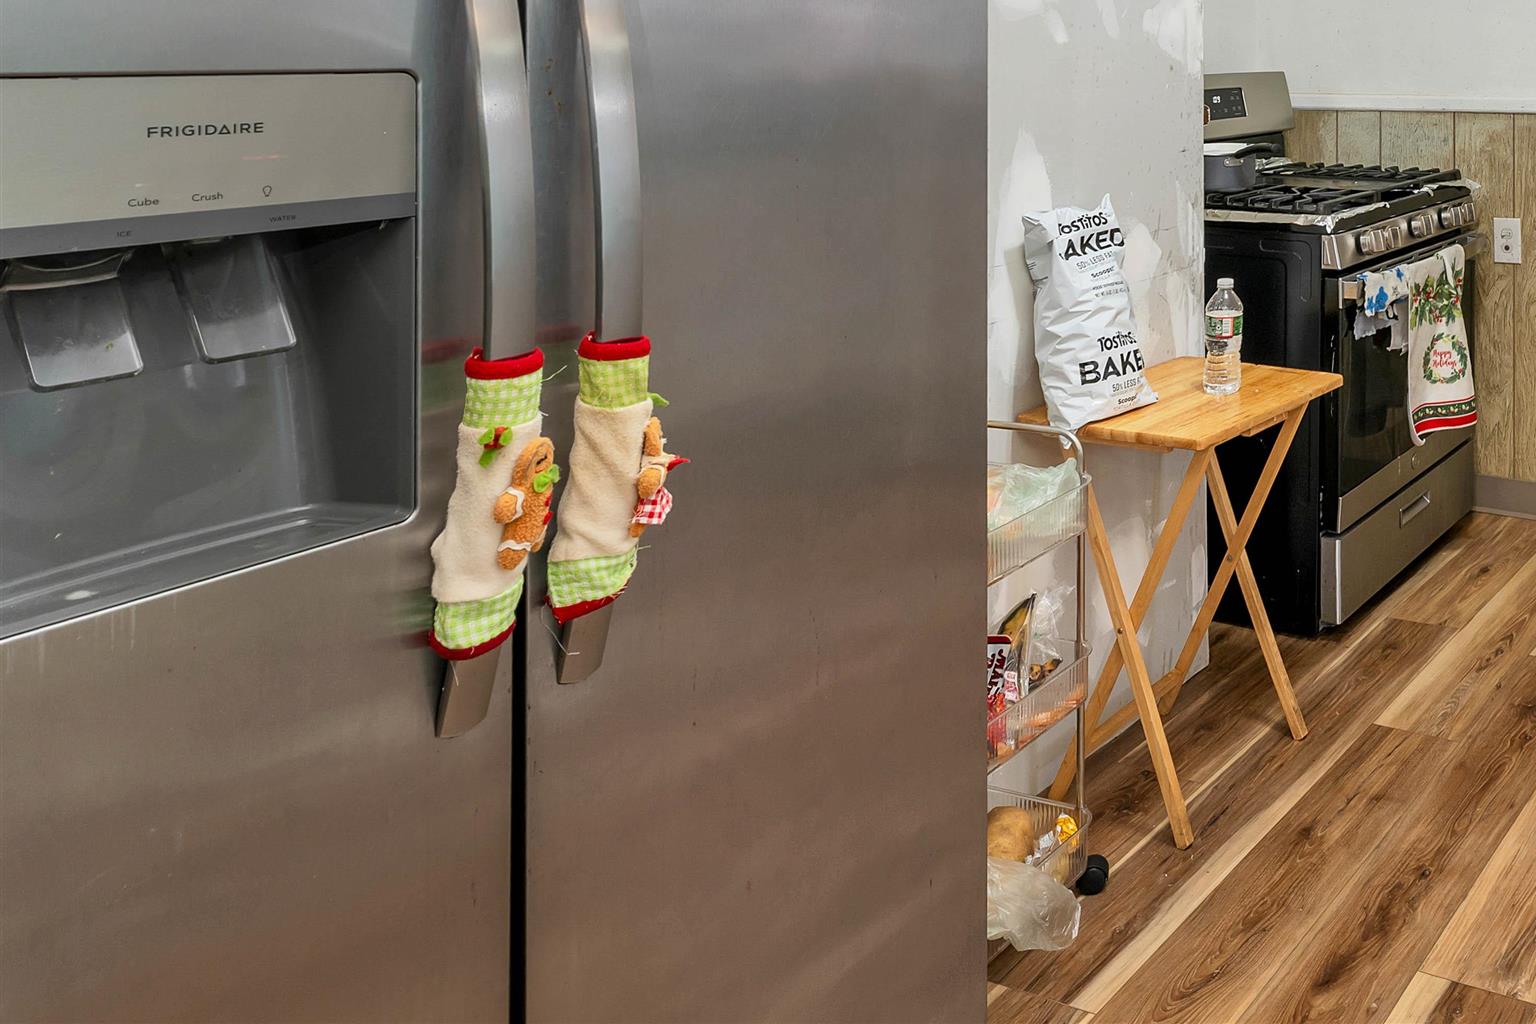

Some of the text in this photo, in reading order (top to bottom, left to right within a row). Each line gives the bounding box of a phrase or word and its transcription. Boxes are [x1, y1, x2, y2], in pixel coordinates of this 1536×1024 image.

[147, 122, 264, 138] FRIGIDAIRE
[127, 191, 224, 208] Cube Crush
[269, 214, 297, 223] WATER
[116, 230, 132, 238] ICE
[1059, 228, 1125, 261] AKED
[1090, 253, 1105, 265] LESS
[1433, 349, 1452, 360] Happy
[1079, 348, 1145, 386] BAKE
[1123, 379, 1137, 389] LESS
